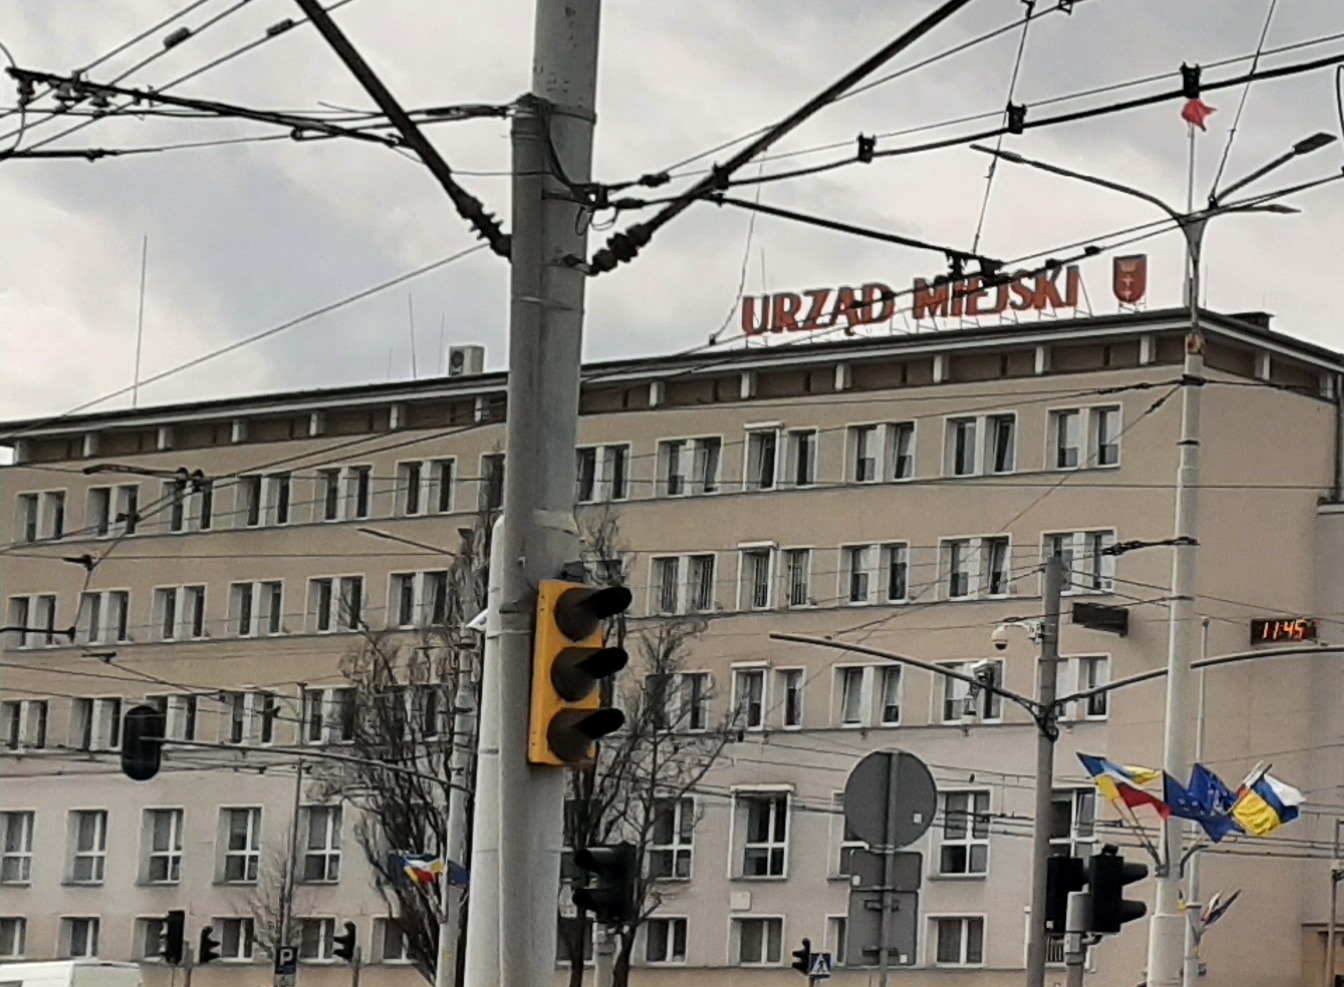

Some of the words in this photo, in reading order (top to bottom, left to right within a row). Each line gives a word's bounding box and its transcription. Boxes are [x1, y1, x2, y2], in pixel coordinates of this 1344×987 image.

[741, 283, 895, 336] URZĄD
[912, 265, 1079, 319] MIEJSKI
[1262, 620, 1307, 639] 11:45
[280, 948, 293, 967] P
